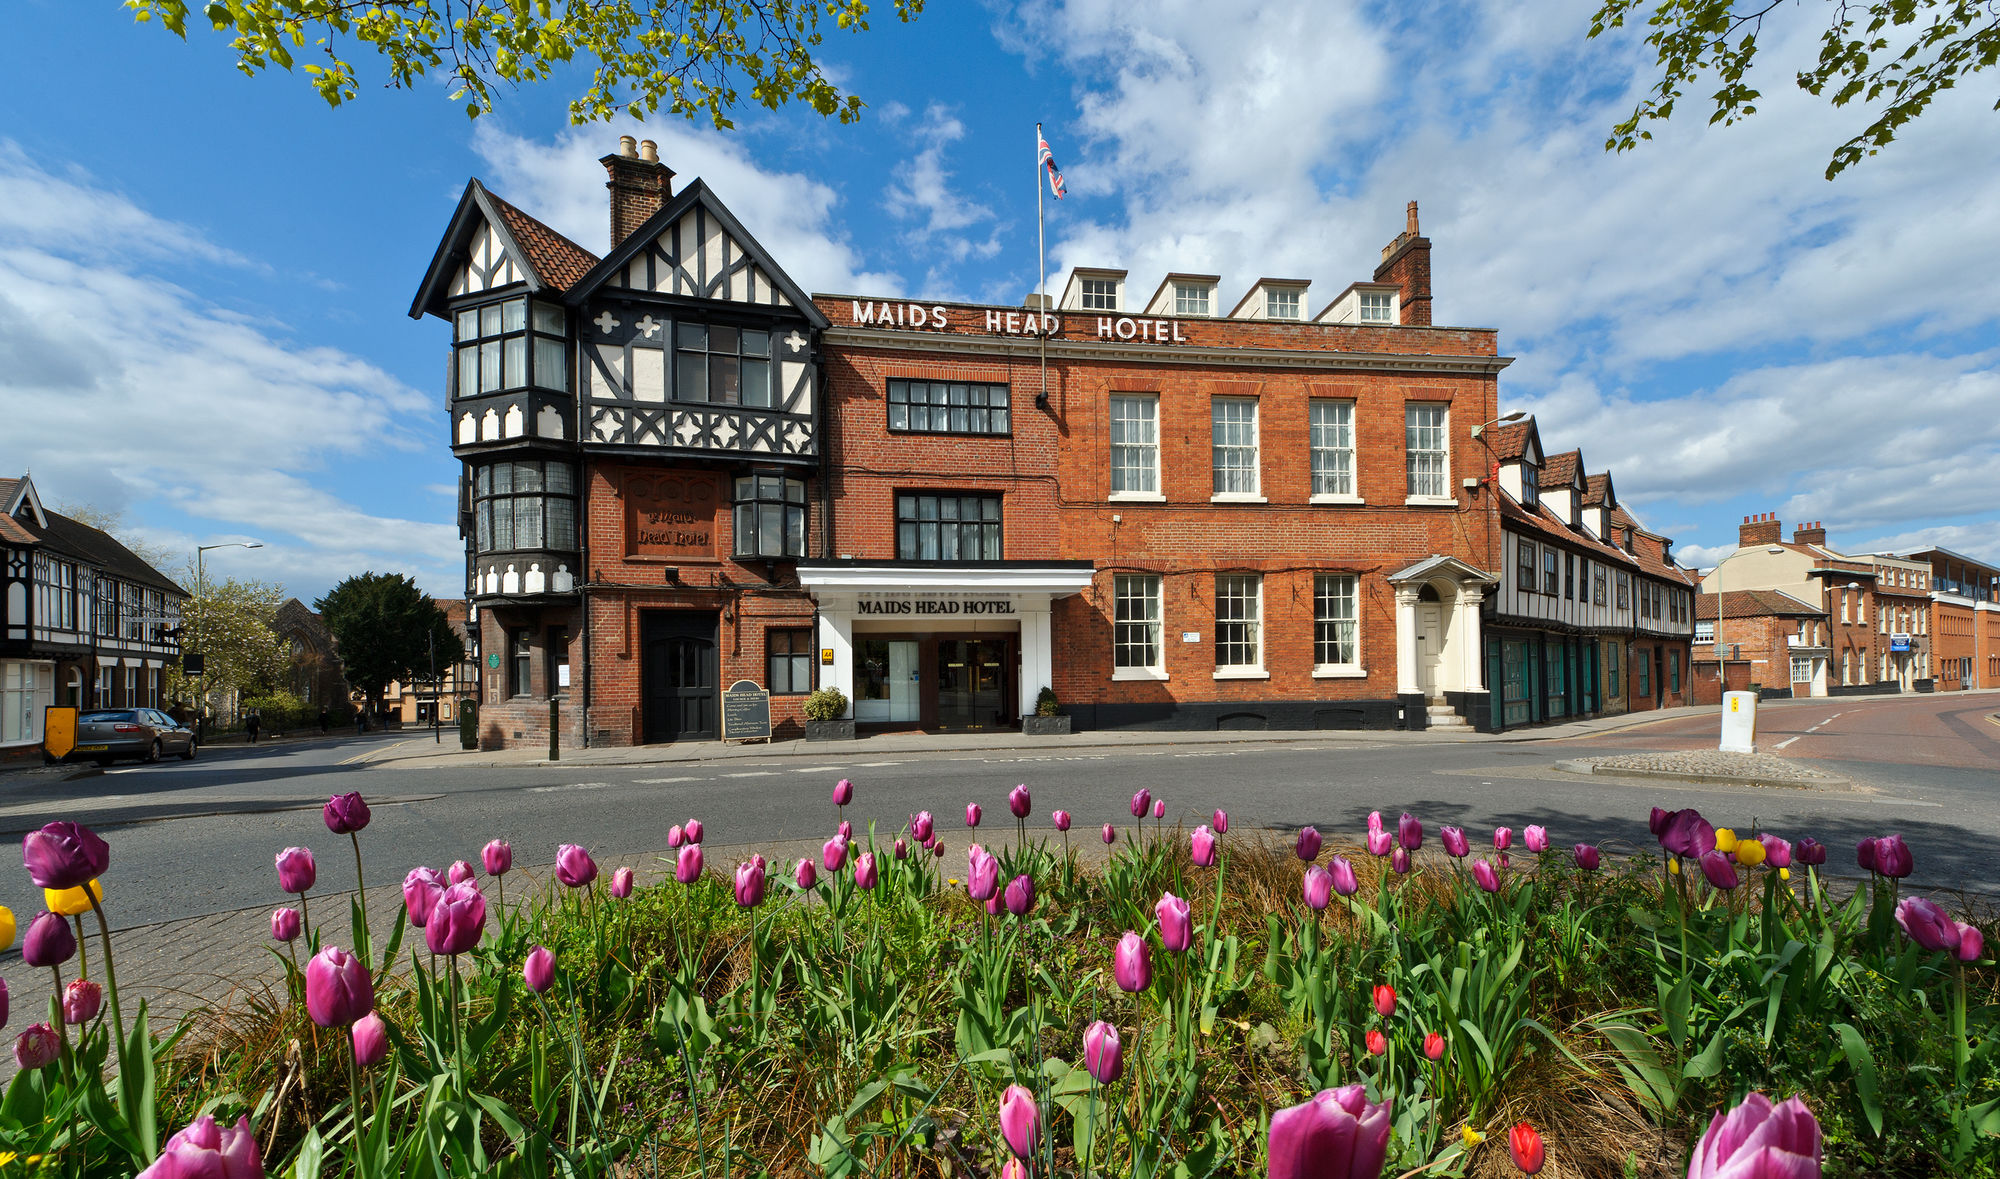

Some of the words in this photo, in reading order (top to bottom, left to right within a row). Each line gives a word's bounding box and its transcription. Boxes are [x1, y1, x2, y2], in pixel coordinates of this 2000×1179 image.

[852, 300, 948, 329] MAIDS
[985, 309, 1060, 335] HEAD
[1097, 316, 1187, 342] HOTEL
[858, 601, 911, 615] MAIDS
[915, 601, 959, 614] HEAD
[963, 601, 1015, 614] HOTEL
